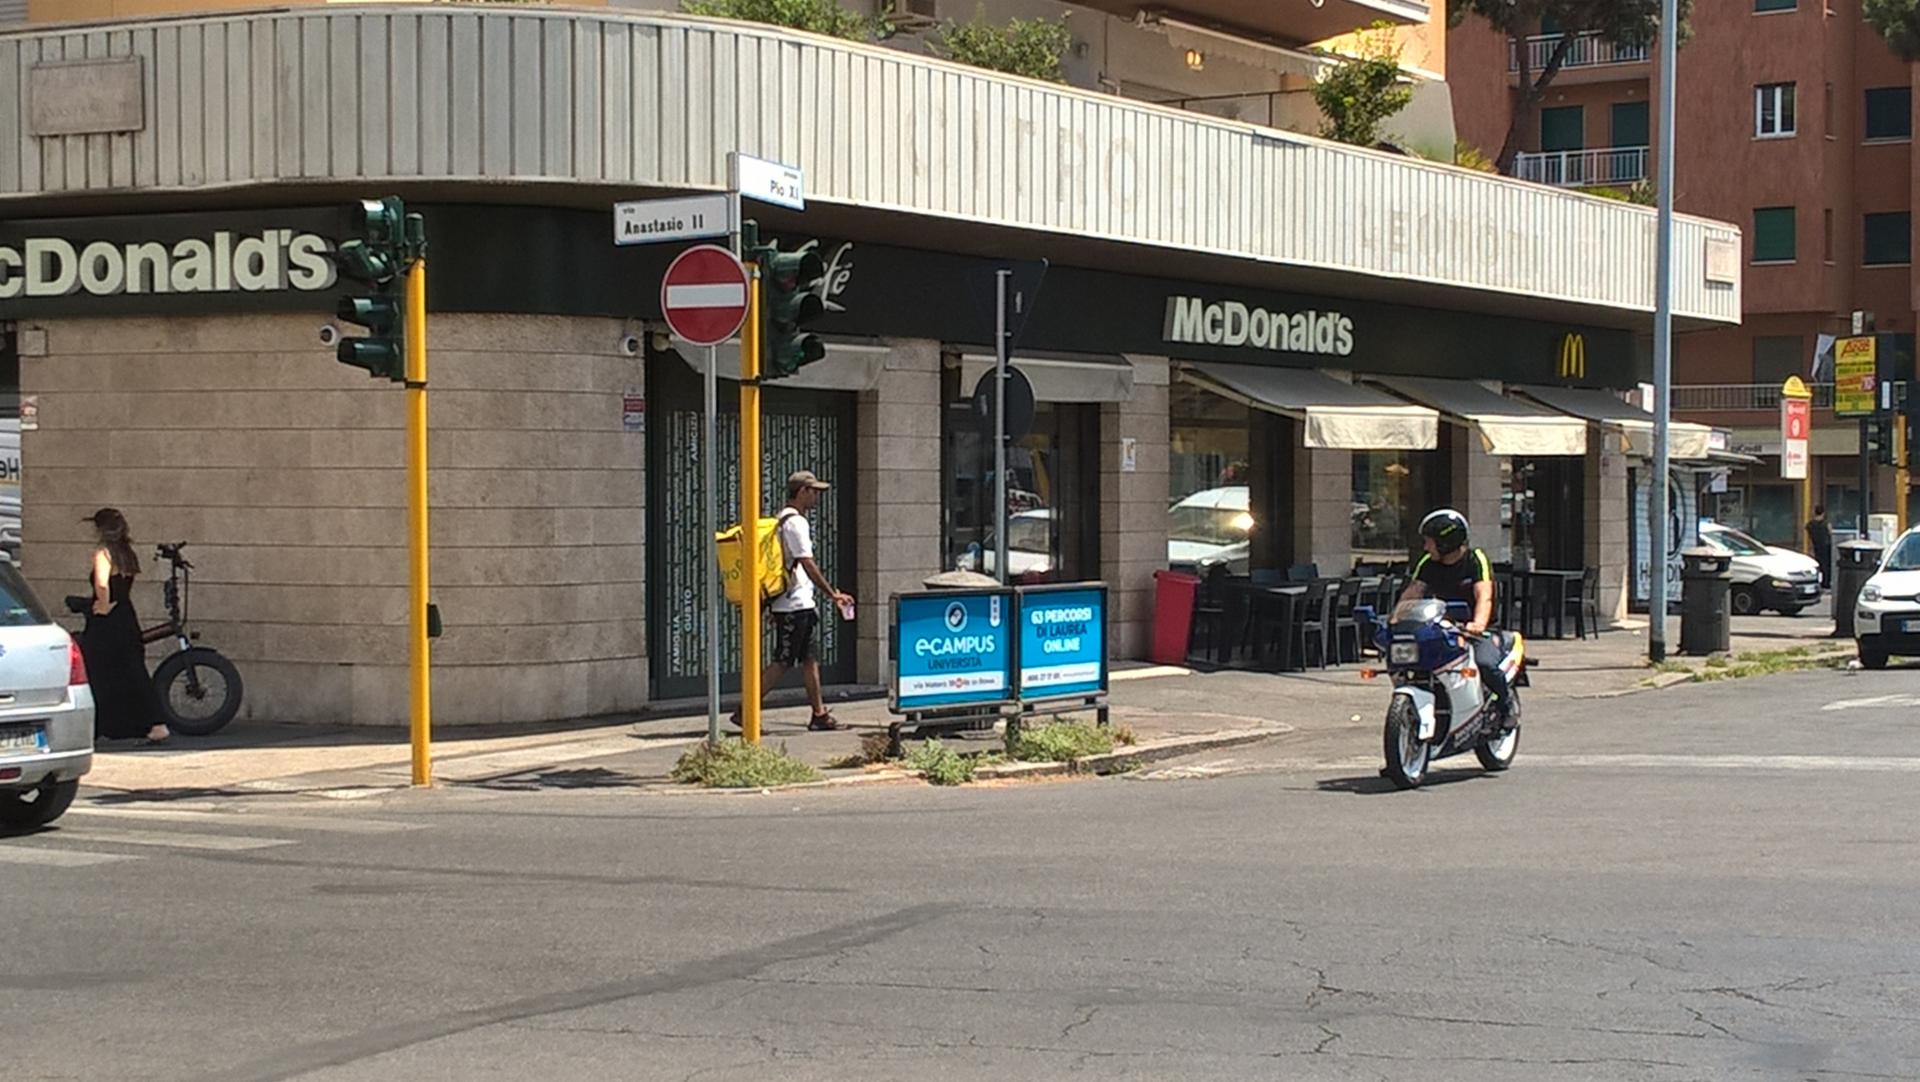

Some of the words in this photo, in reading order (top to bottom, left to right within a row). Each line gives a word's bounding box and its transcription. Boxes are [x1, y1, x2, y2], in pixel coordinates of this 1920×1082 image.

[770, 180, 784, 197] Pio
[624, 216, 684, 236] Anastasio
[1170, 296, 1354, 356] McDonald's
[684, 588, 692, 632] GUSTO
[1045, 607, 1092, 623] PERCORSI
[1036, 626, 1047, 638] DI
[1050, 623, 1087, 637] LAUREA
[672, 615, 681, 673] FAMIGLIA
[1044, 638, 1080, 653] ONLINE
